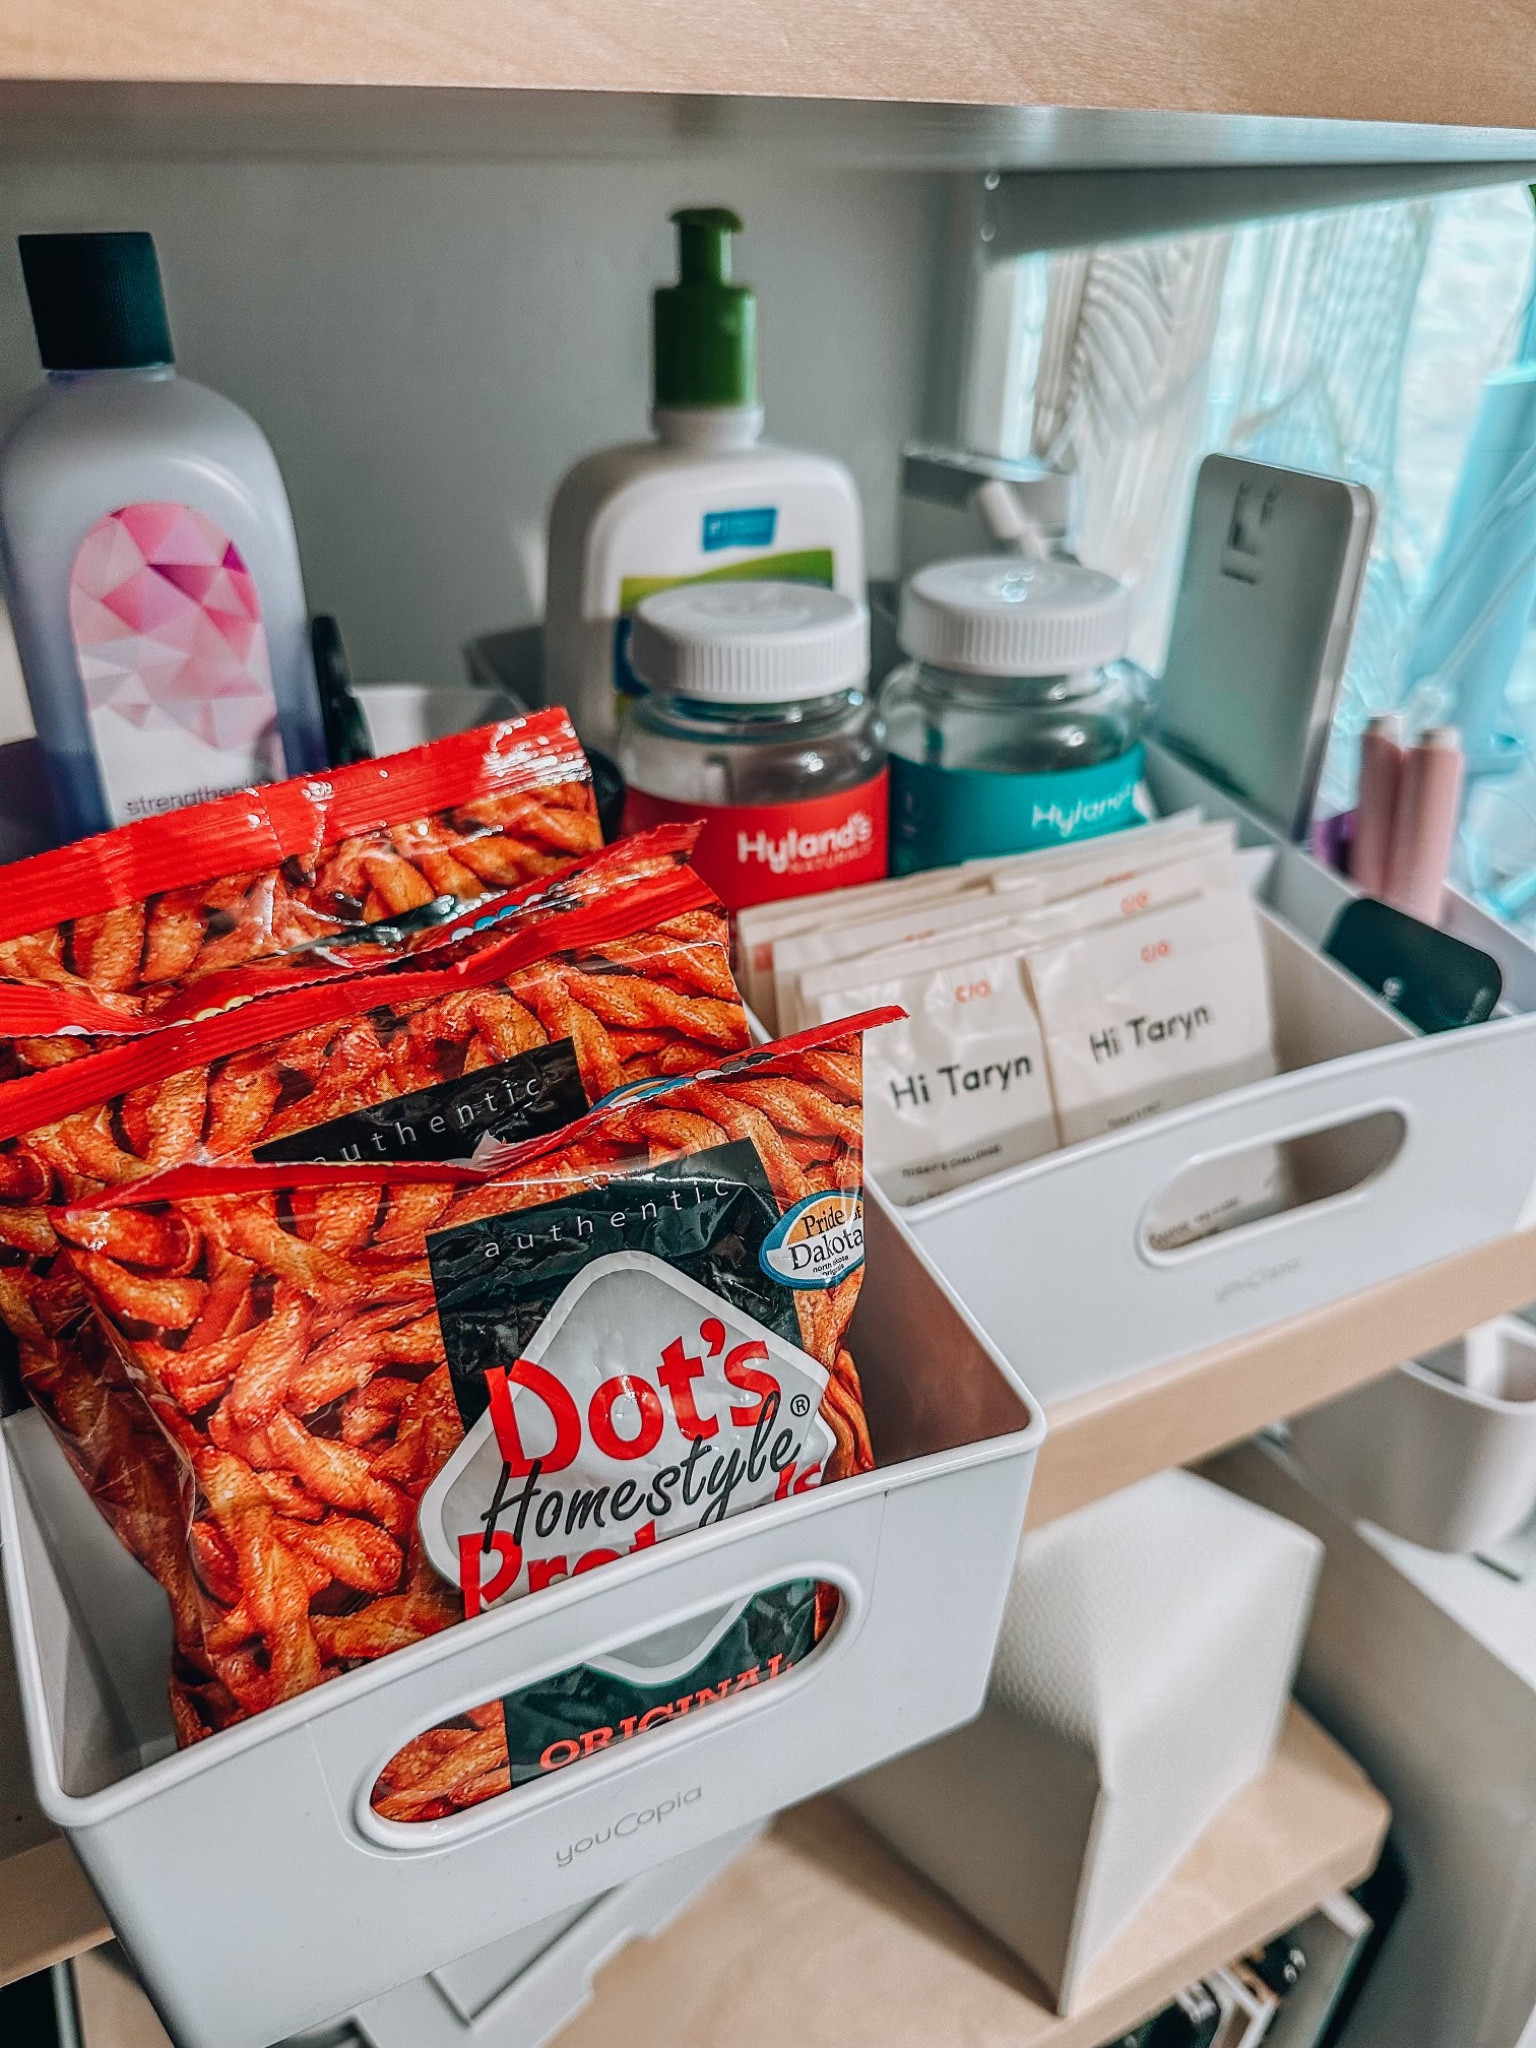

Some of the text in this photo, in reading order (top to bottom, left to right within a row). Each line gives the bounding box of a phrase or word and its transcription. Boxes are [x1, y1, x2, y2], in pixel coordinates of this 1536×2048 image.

[1089, 1005, 1210, 1063] Hi Taryn
[890, 1056, 1032, 1109] Hi Taryn
[484, 1178, 730, 1258] authentic
[801, 1206, 845, 1239] Pride
[788, 1228, 863, 1271] Dakota
[832, 1254, 849, 1267] akota
[484, 1317, 781, 1478] Dot's
[481, 1391, 802, 1553] Homestyle
[556, 1786, 702, 1868] youCopia
